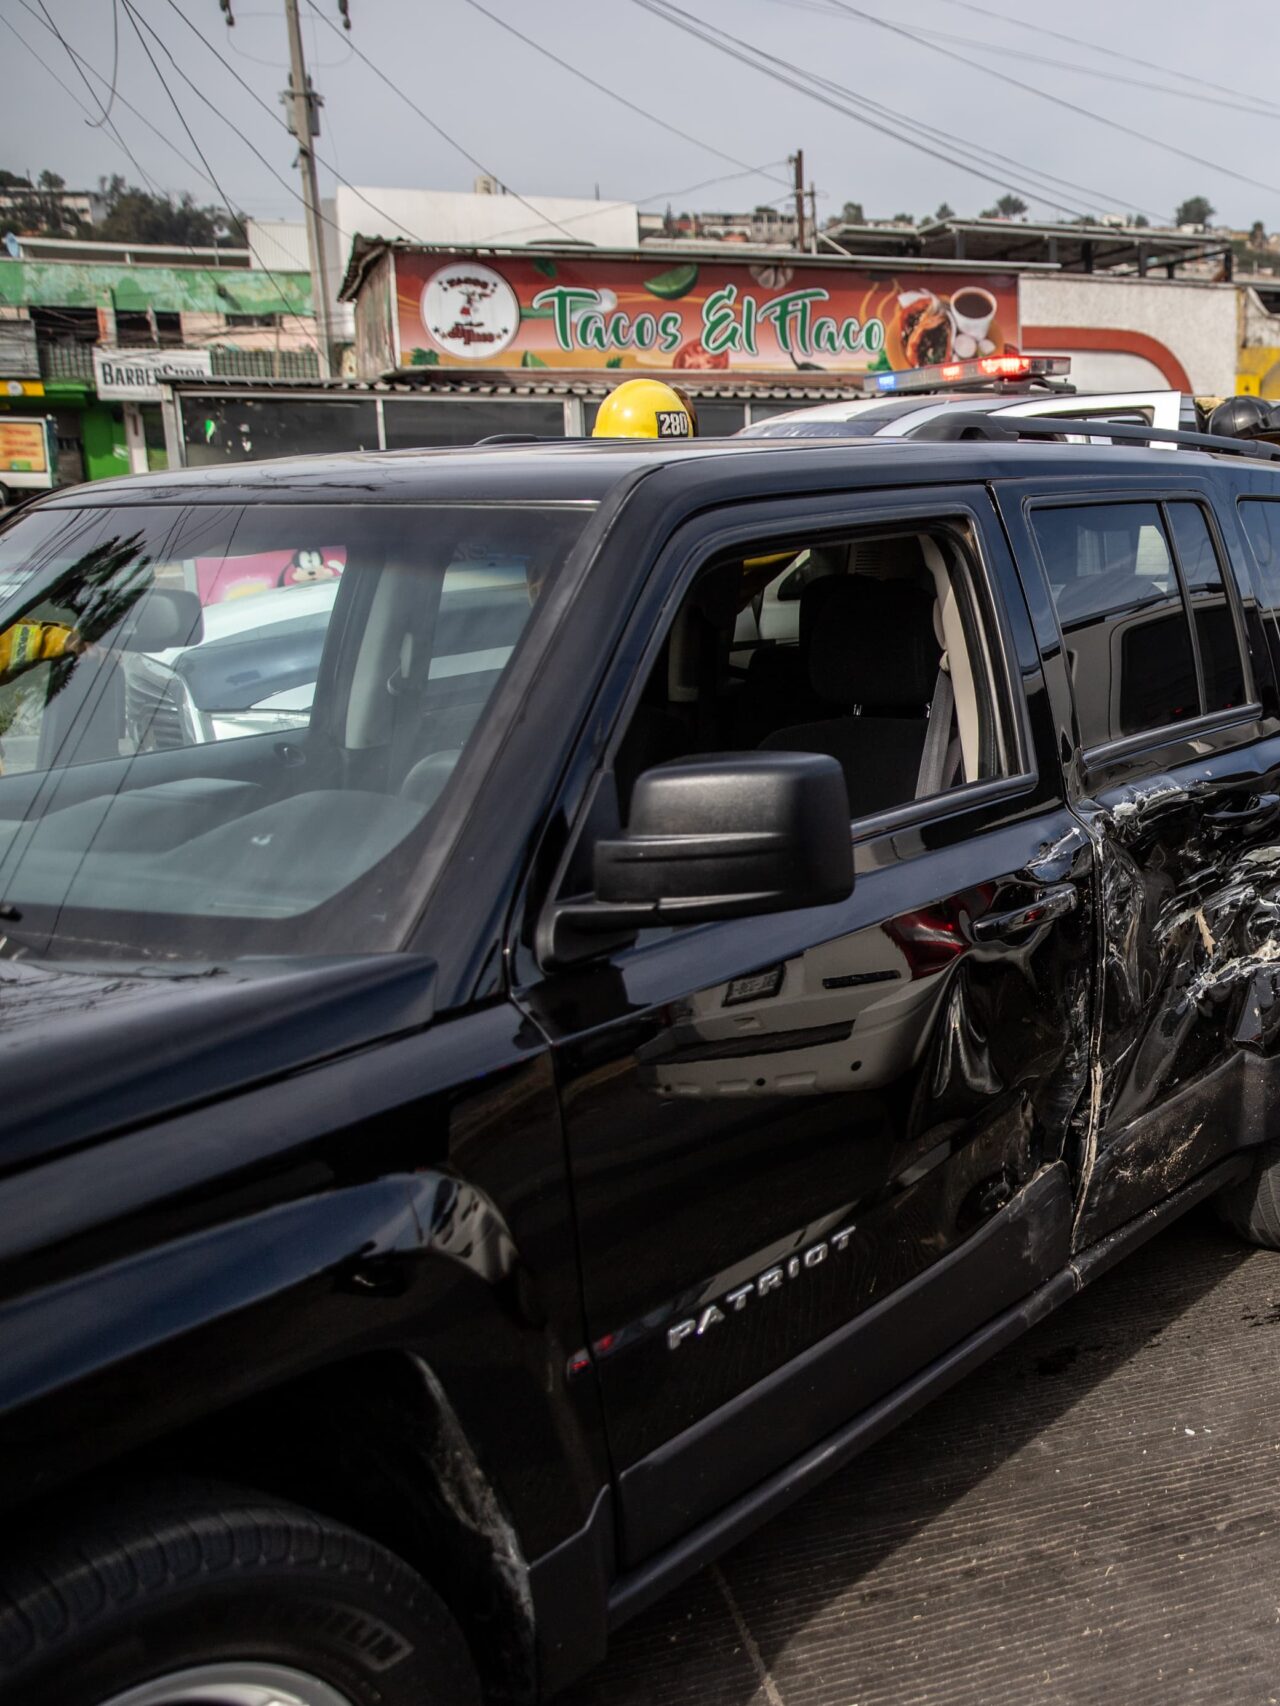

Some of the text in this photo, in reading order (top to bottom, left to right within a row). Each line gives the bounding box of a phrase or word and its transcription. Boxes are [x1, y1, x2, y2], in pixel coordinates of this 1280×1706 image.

[533, 284, 886, 356] Tacos El Flaco
[659, 412, 688, 435] 280
[668, 1225, 857, 1350] PATRIOT
